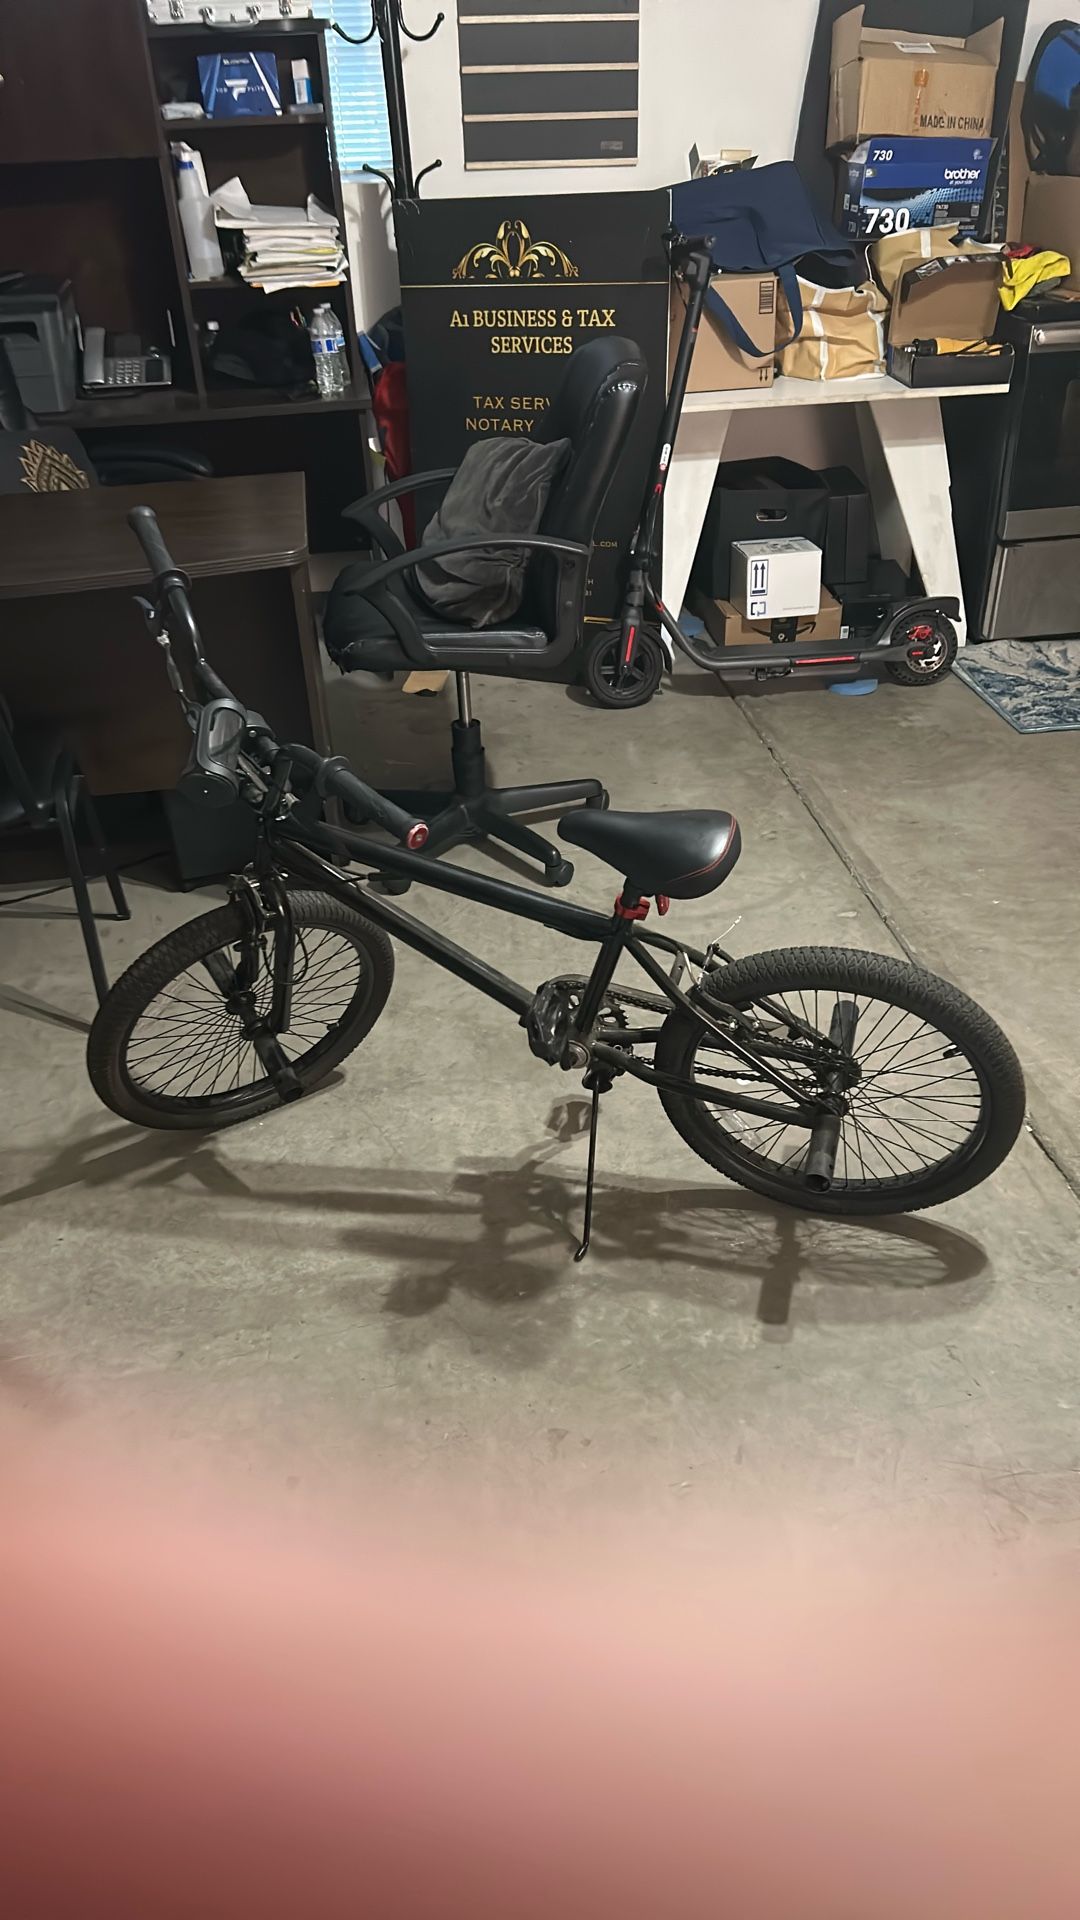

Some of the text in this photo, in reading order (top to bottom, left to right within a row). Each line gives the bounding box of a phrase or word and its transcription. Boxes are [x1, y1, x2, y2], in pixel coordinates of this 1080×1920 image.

[947, 116, 957, 129] IN
[958, 116, 985, 130] CHINA
[872, 150, 894, 161] 730
[944, 168, 981, 180] brother
[865, 208, 910, 234] 730
[472, 310, 557, 328] BUSINESS
[561, 309, 573, 327] &
[577, 309, 616, 327] TAX
[491, 336, 573, 354] SERVICES
[473, 396, 505, 409] TAX
[465, 418, 534, 432] NOTARY
